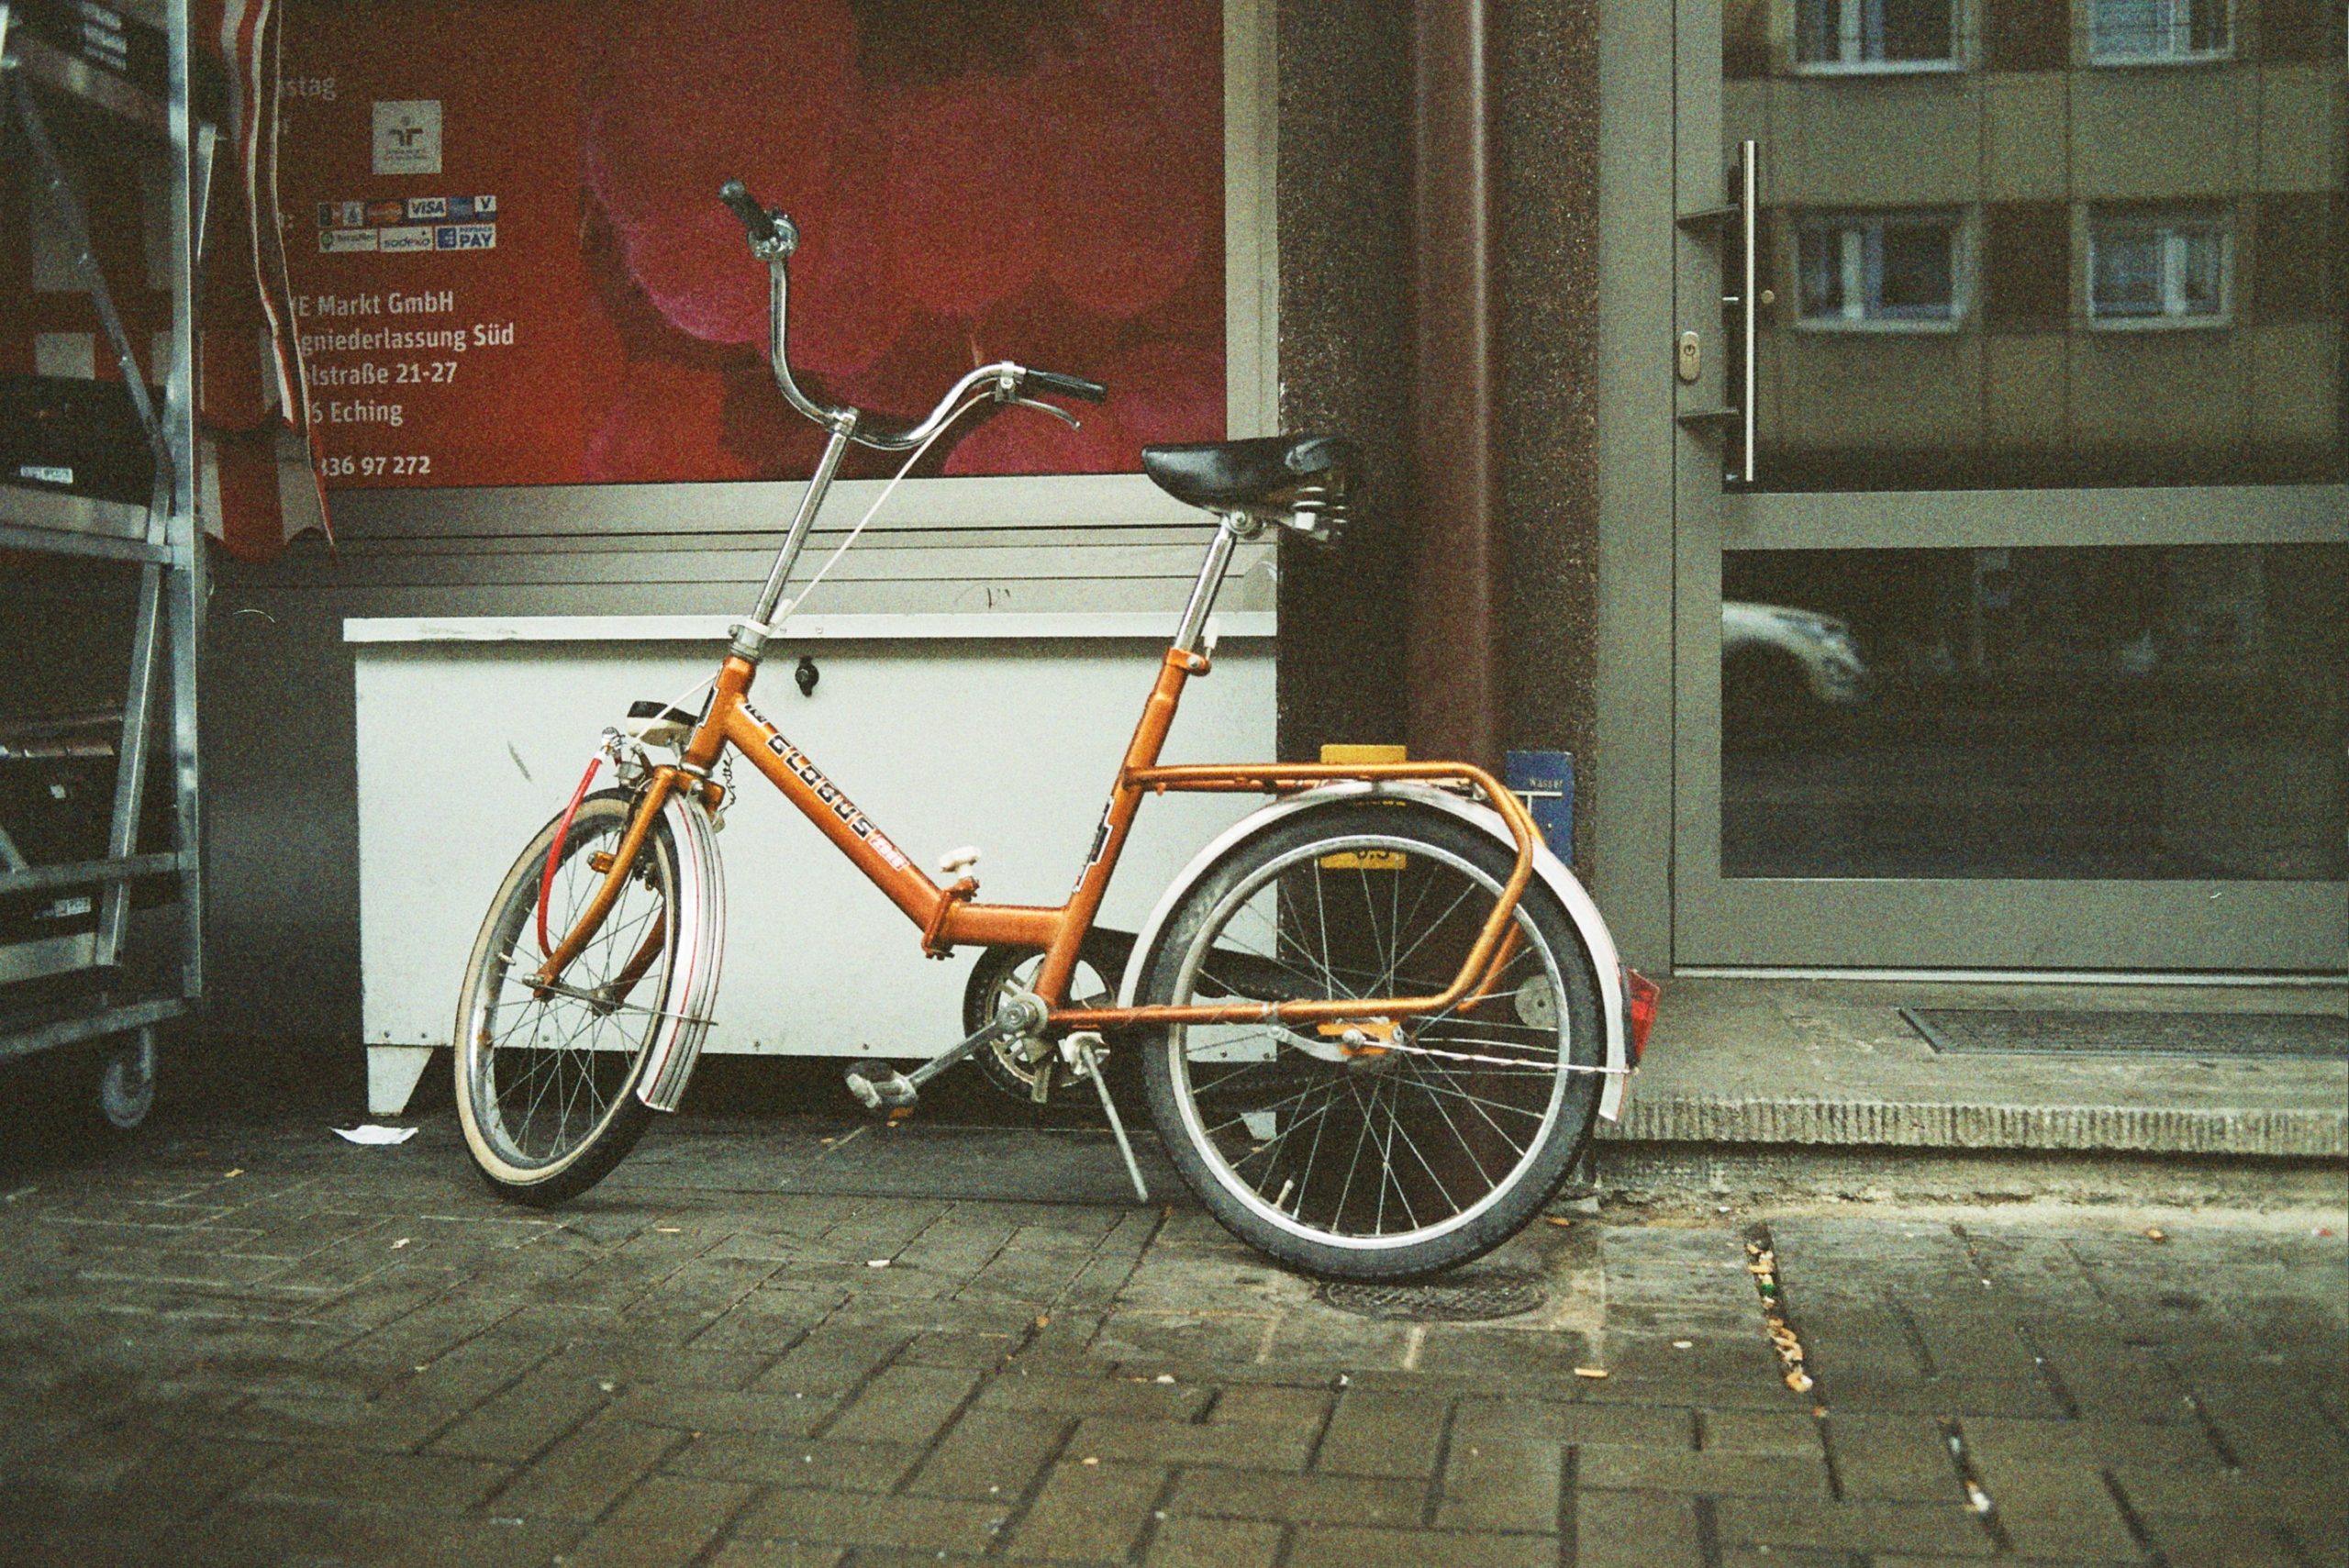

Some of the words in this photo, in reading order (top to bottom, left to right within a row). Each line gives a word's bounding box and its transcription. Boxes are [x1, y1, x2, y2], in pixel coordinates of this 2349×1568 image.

[411, 200, 445, 215] VISA
[459, 233, 492, 248] PAY
[318, 294, 381, 317] Markt
[388, 291, 454, 313] GmbH
[473, 322, 515, 347] Süd
[395, 361, 458, 384] 21-27
[330, 399, 404, 428] Eching
[362, 457, 386, 476] 97
[393, 456, 431, 475] 272
[767, 734, 875, 839] GLOBUS
